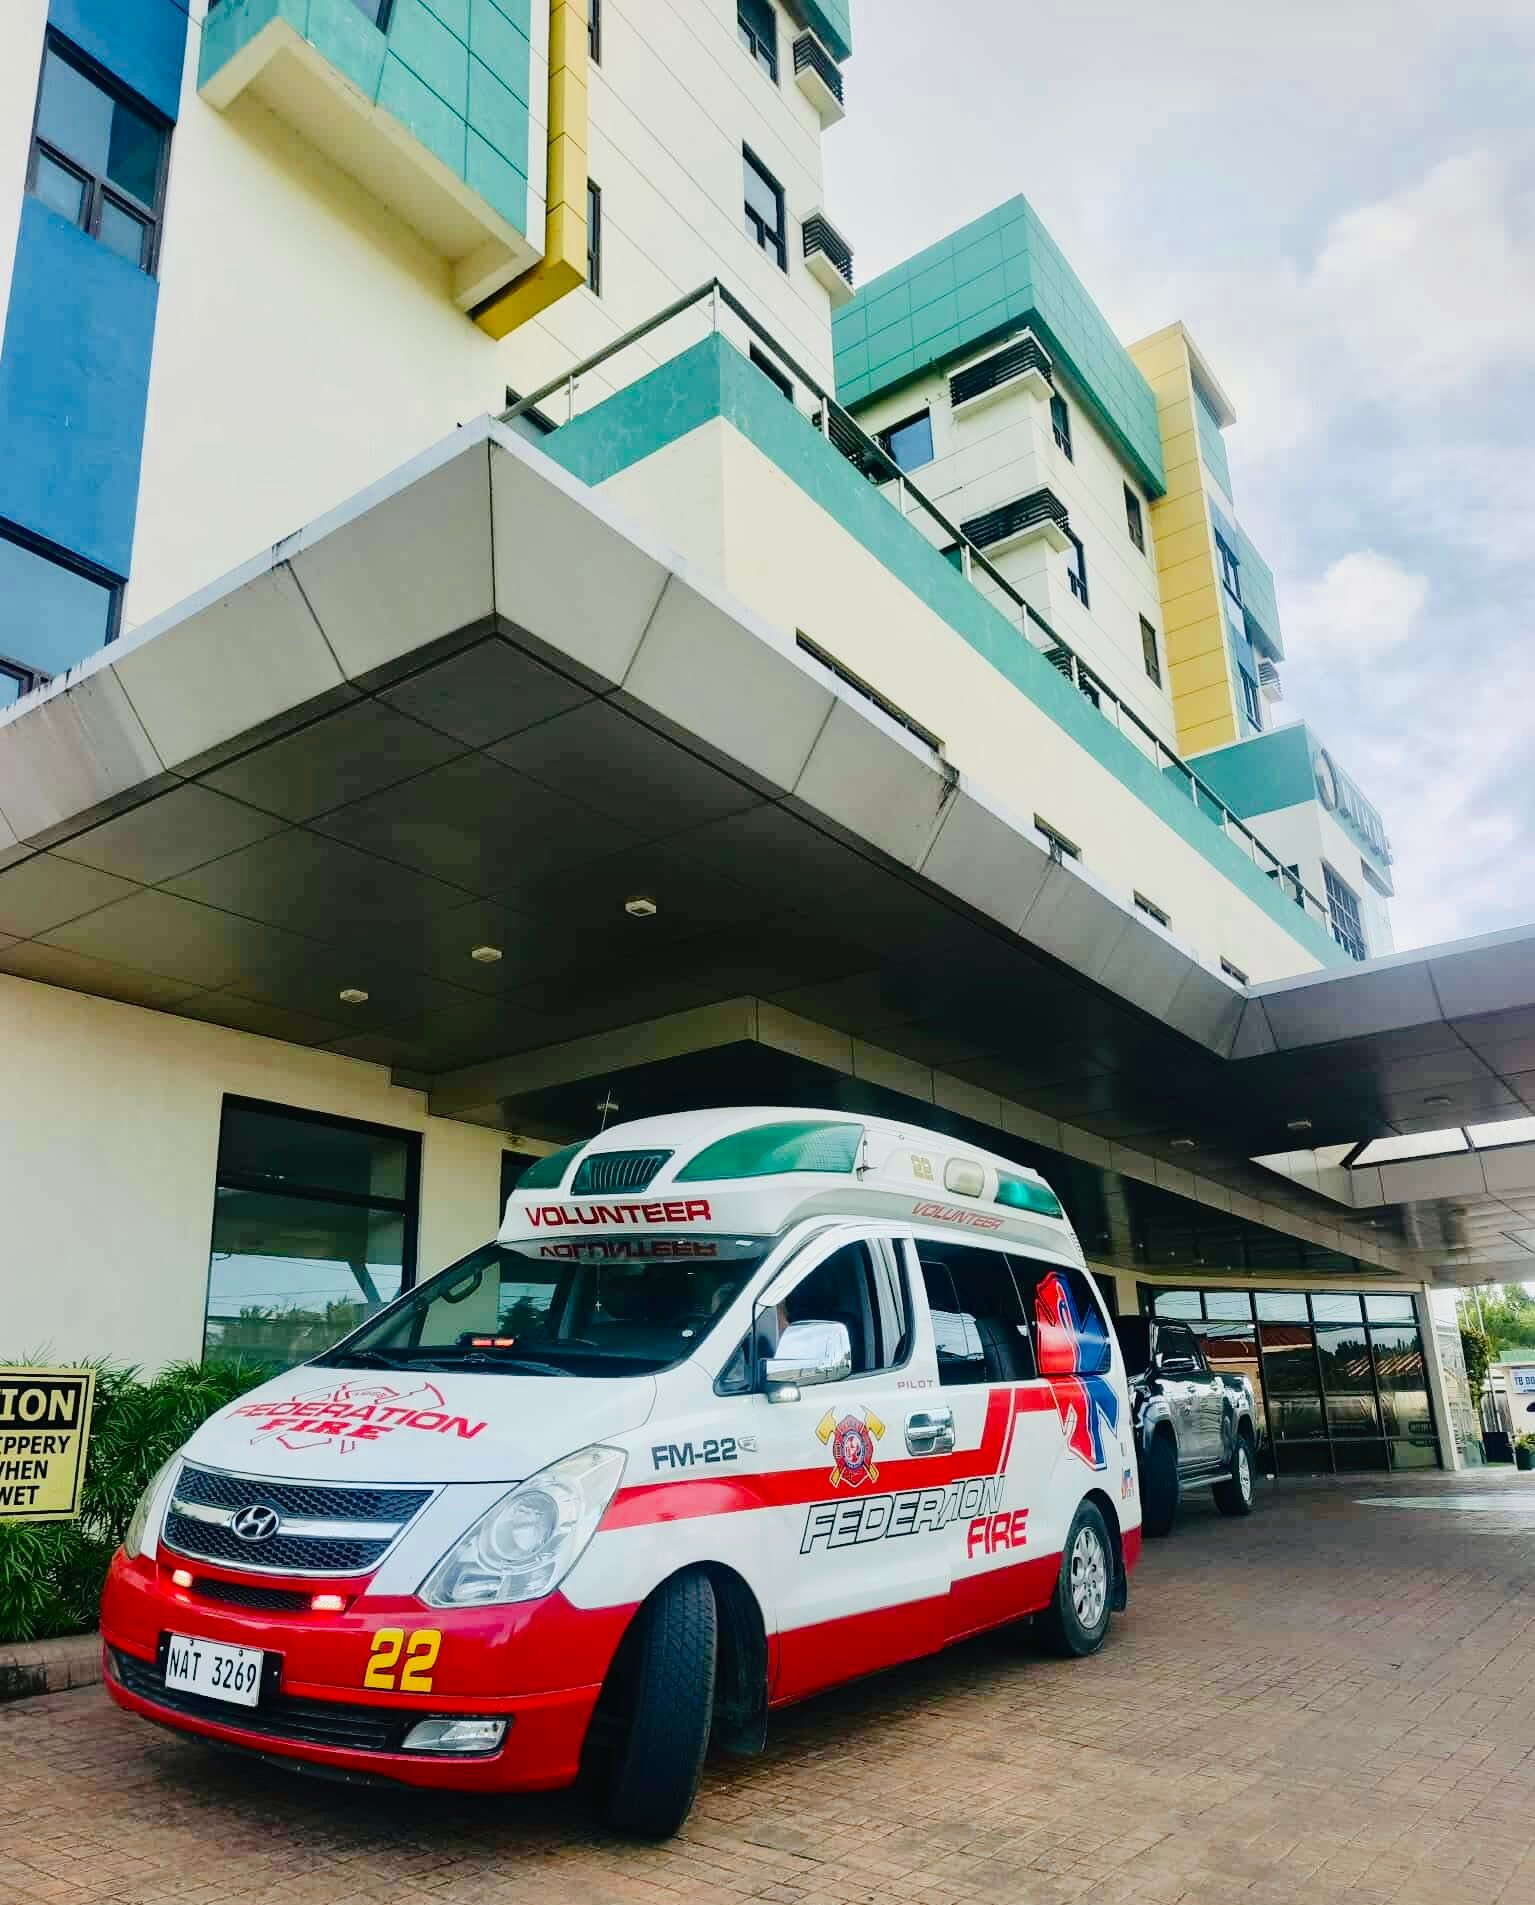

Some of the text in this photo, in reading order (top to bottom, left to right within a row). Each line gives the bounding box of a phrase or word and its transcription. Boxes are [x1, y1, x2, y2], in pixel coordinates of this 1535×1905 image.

[525, 1200, 711, 1227] VOLUNTEER
[911, 1202, 1006, 1230] VOLUNTEER
[897, 1379, 933, 1389] PILOT
[0, 1388, 76, 1422] ION
[225, 1402, 488, 1439] FEDERATION
[256, 1419, 395, 1441] FIRE
[0, 1435, 71, 1455] PPERY
[651, 1437, 738, 1470] FM-22
[0, 1460, 48, 1480] HEN
[967, 1508, 1029, 1559] FIRE
[168, 1647, 258, 1694] NAT 3269
[364, 1627, 442, 1693] 22
